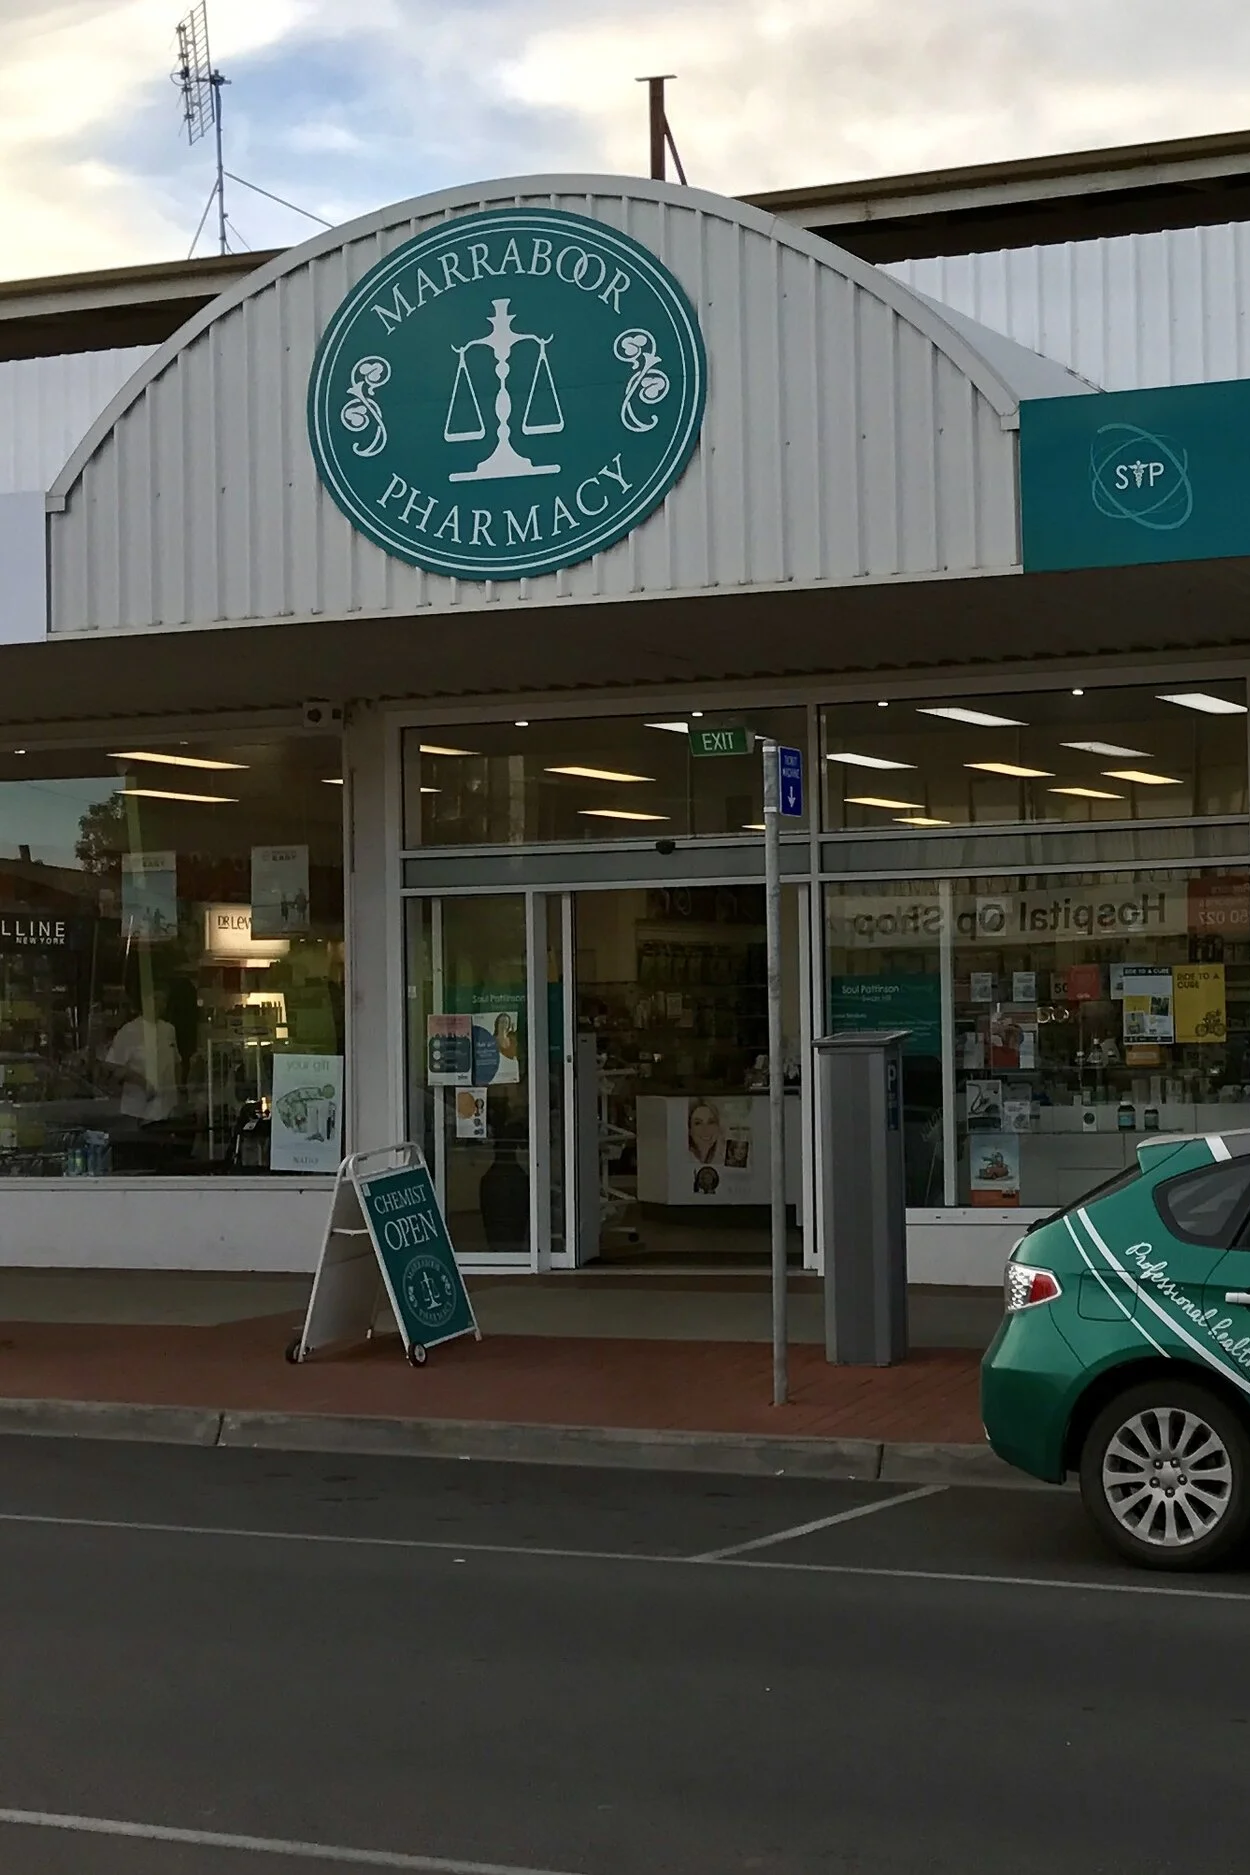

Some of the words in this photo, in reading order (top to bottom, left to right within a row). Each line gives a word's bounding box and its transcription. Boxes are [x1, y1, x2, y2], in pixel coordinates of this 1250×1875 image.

[370, 238, 631, 335] MARRABOOR
[376, 453, 634, 548] PHARMACY
[701, 732, 734, 751] EXIT
[16, 937, 37, 945] NEW
[40, 937, 65, 945] YORK
[842, 985, 859, 994] Soul
[860, 984, 899, 994] Pattinson
[374, 1184, 427, 1215] CHEMIST
[384, 1209, 439, 1251] OPEN
[1125, 1242, 1218, 1327] Professional
